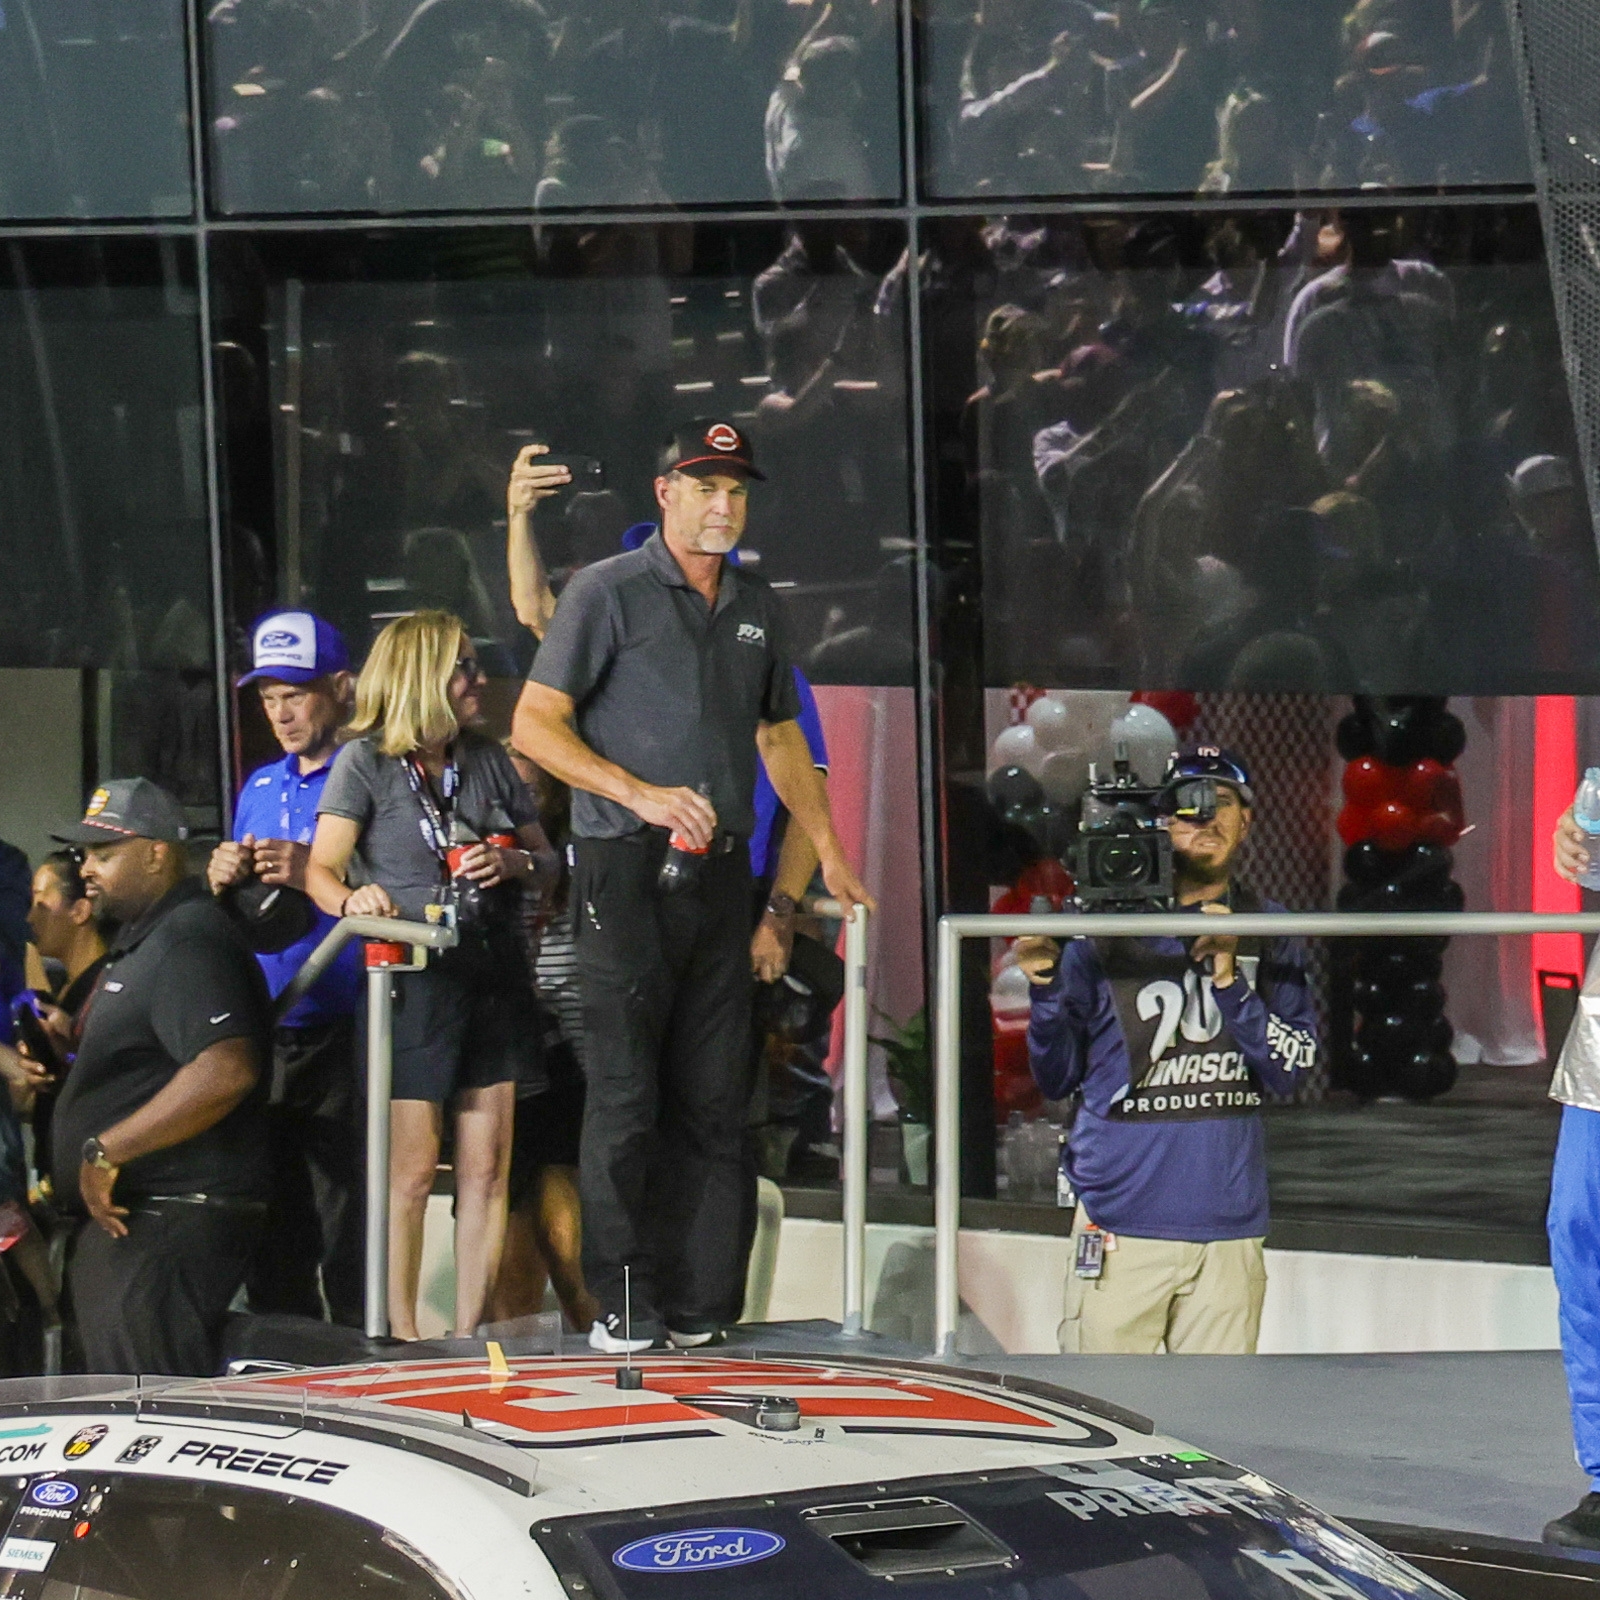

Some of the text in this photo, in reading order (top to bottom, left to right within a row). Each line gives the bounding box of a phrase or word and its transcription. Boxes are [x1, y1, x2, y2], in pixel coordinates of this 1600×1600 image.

[1122, 1090, 1262, 1114] PRODUCTIONS
[169, 1440, 350, 1486] PREECE
[37, 1483, 71, 1503] Ford
[19, 1506, 73, 1520] RACING
[5, 1548, 45, 1562] SIEMENS
[654, 1532, 754, 1566] Ford
